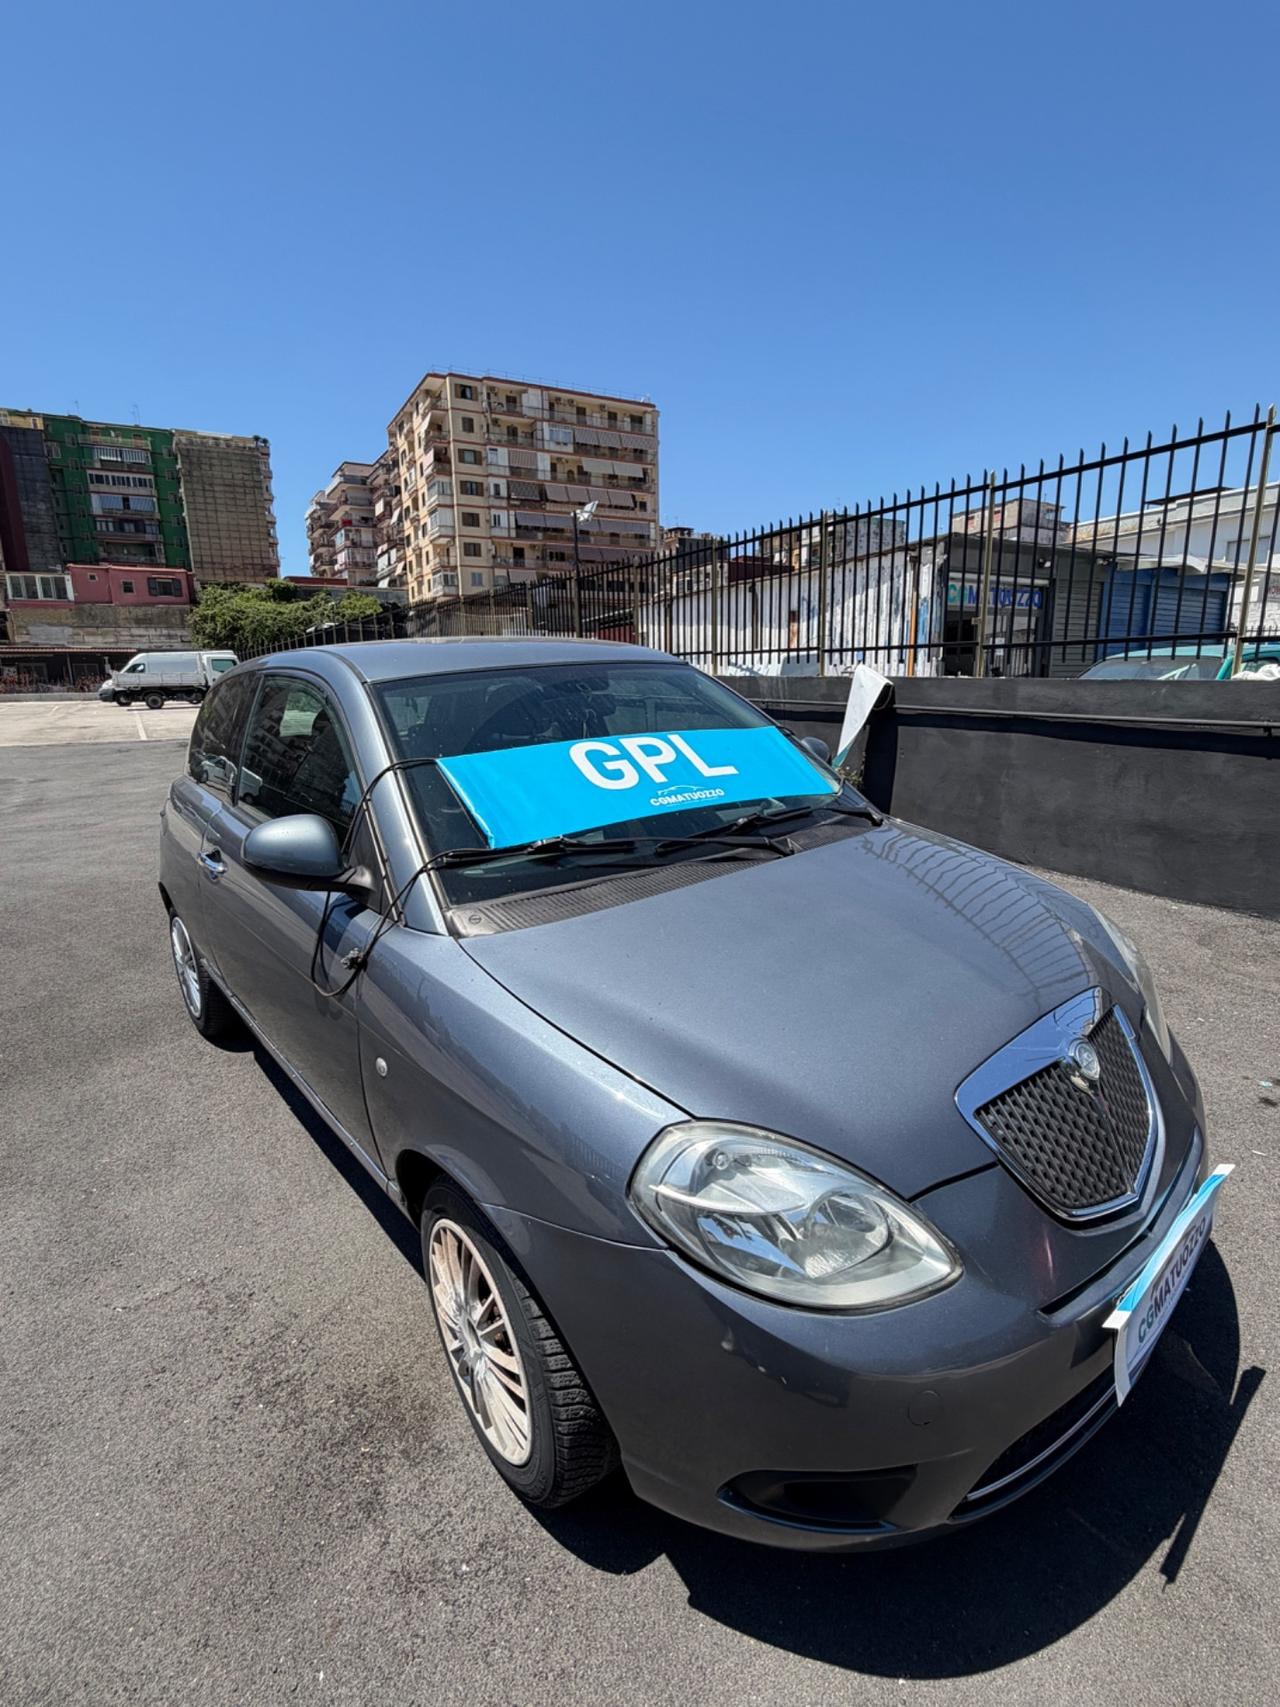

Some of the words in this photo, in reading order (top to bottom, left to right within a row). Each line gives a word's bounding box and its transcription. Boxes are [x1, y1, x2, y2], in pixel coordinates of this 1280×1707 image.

[569, 734, 739, 790] GPL
[650, 788, 725, 806] CGMATUOZZO
[1137, 1216, 1206, 1344] CGMATUOZZO
